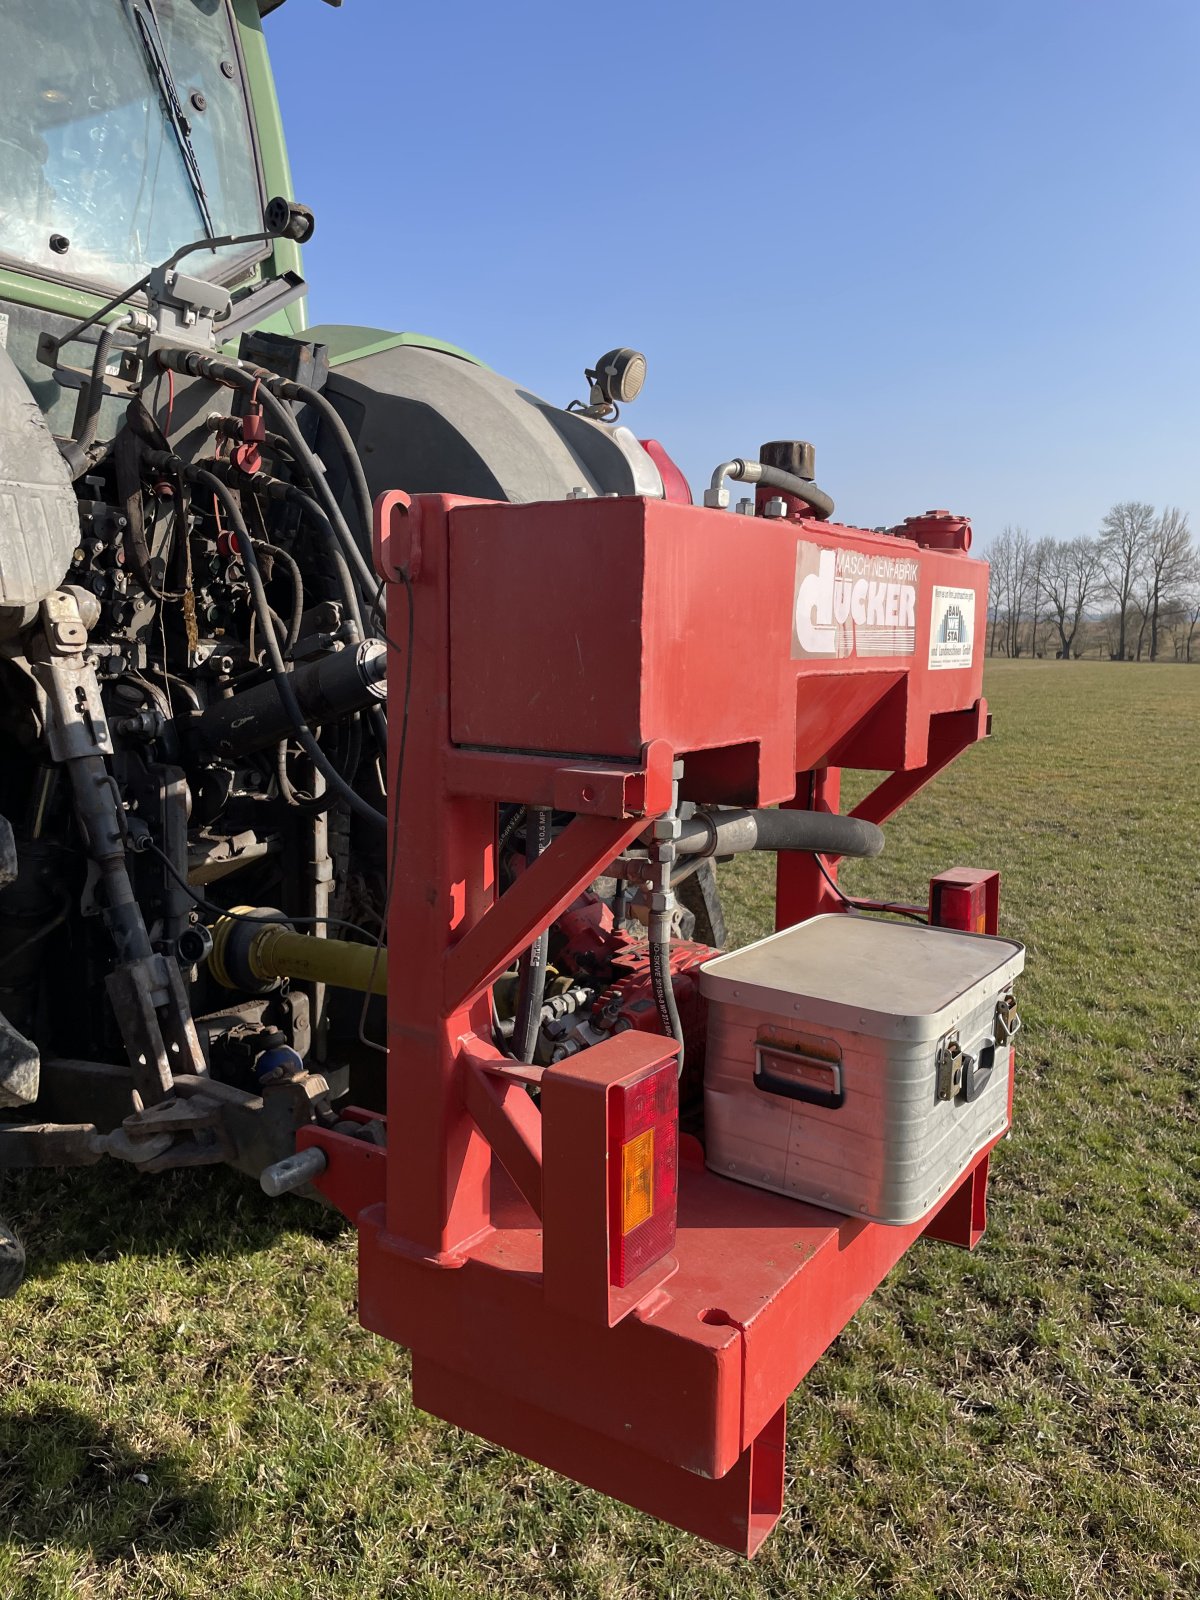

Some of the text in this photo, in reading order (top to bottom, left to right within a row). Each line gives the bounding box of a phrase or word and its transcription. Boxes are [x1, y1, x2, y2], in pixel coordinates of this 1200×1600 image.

[836, 553, 918, 581] MASCHNENFABRIK
[948, 605, 960, 617] BAU
[948, 618, 960, 630] WE
[947, 631, 958, 641] STA
